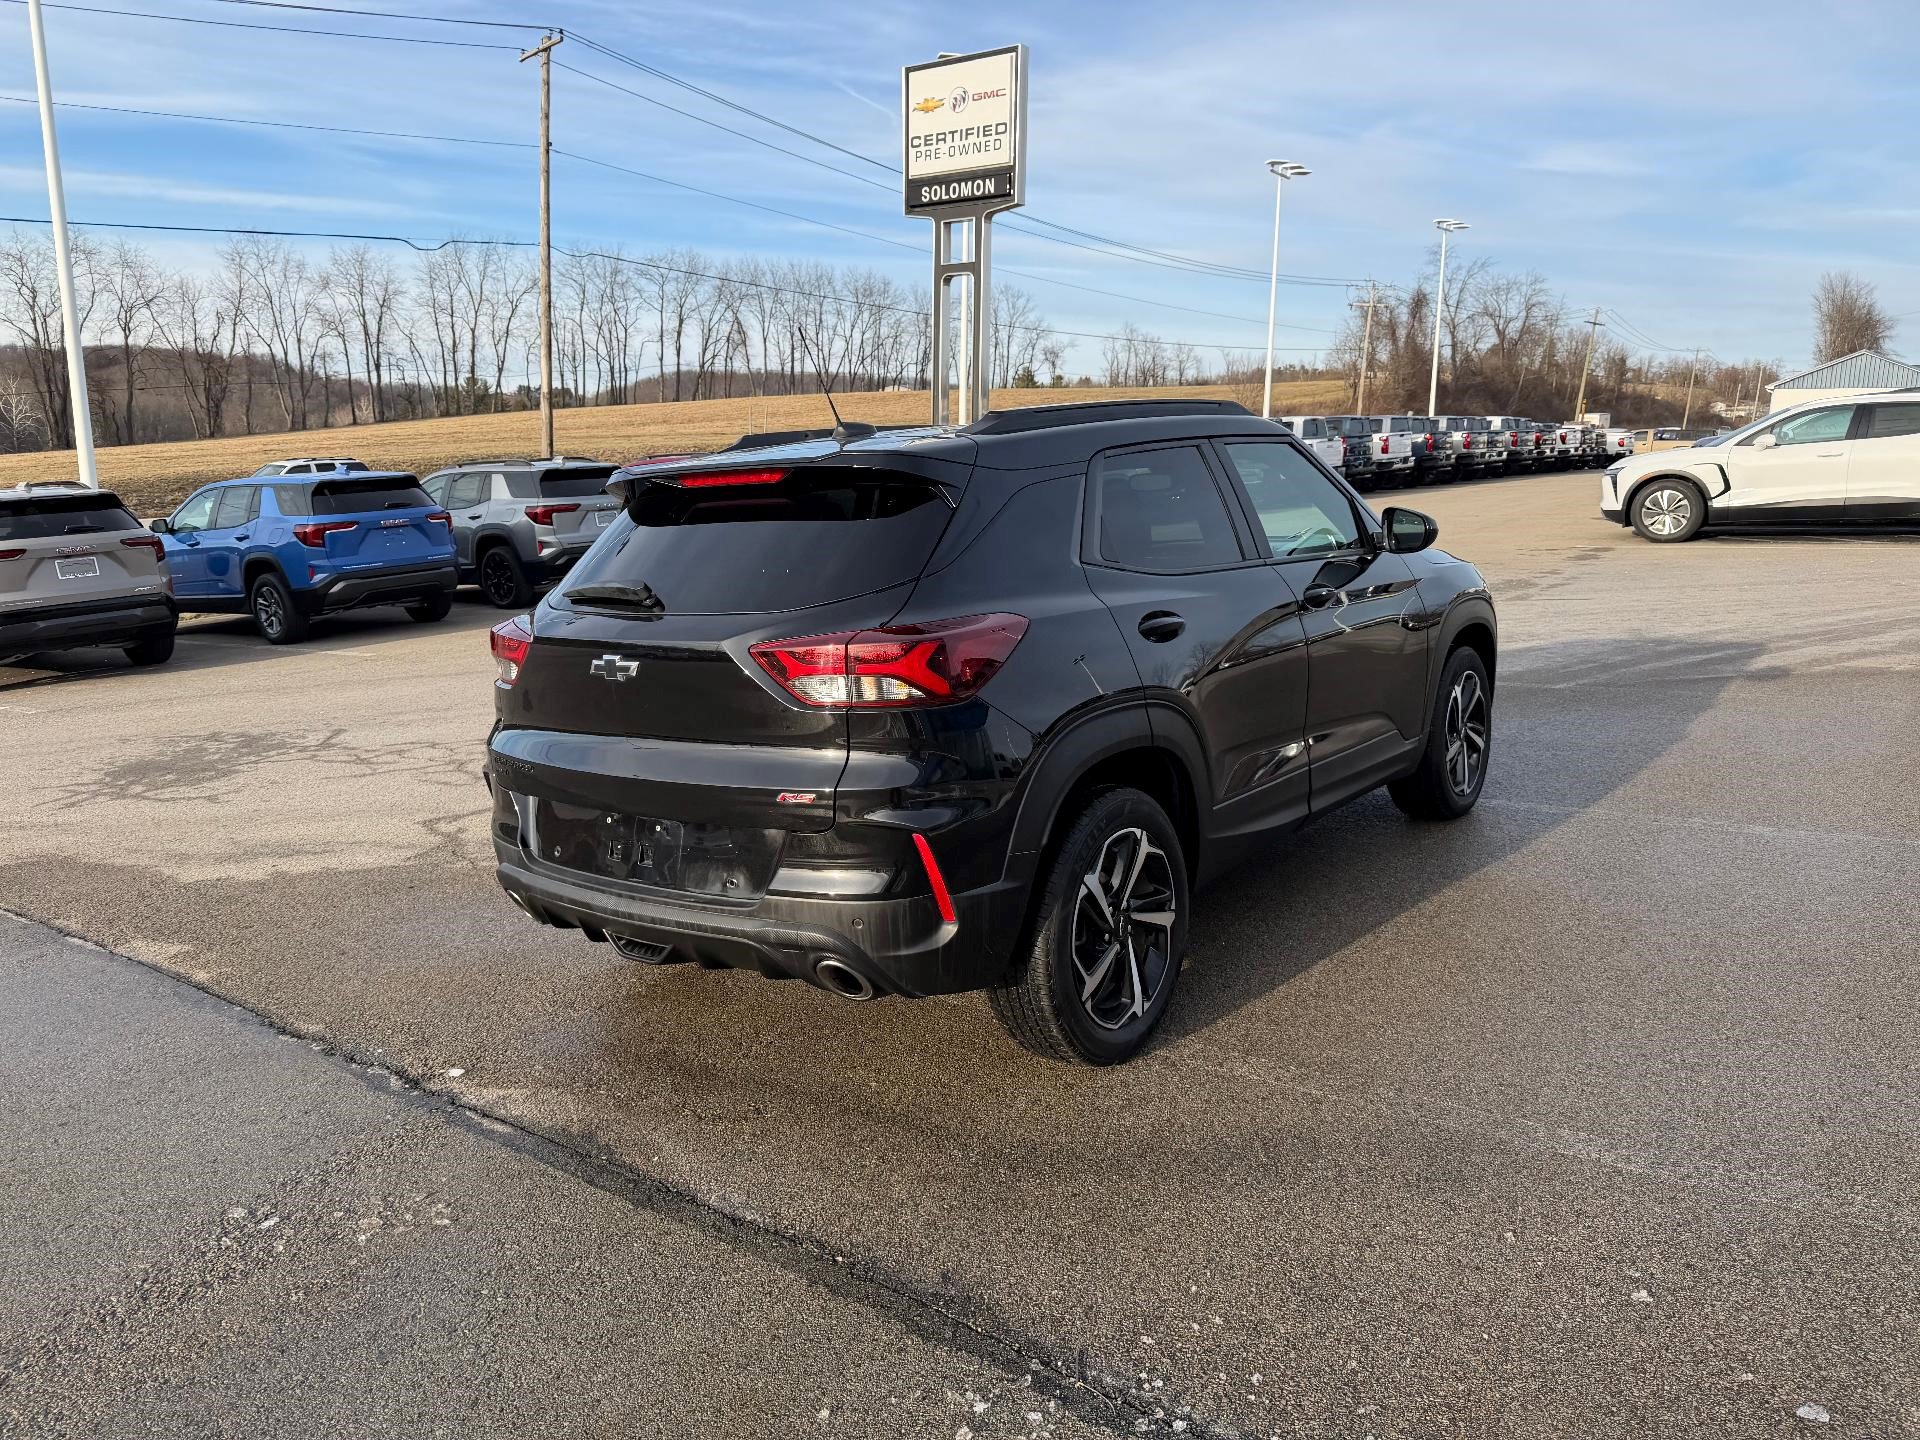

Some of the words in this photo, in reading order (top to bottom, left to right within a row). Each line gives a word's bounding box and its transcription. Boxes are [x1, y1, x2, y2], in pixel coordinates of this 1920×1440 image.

[972, 88, 1007, 102] GMC
[910, 122, 1008, 149] CERTIFIED
[915, 138, 1002, 163] PRE-OWNED
[921, 178, 995, 202] SOLOMON
